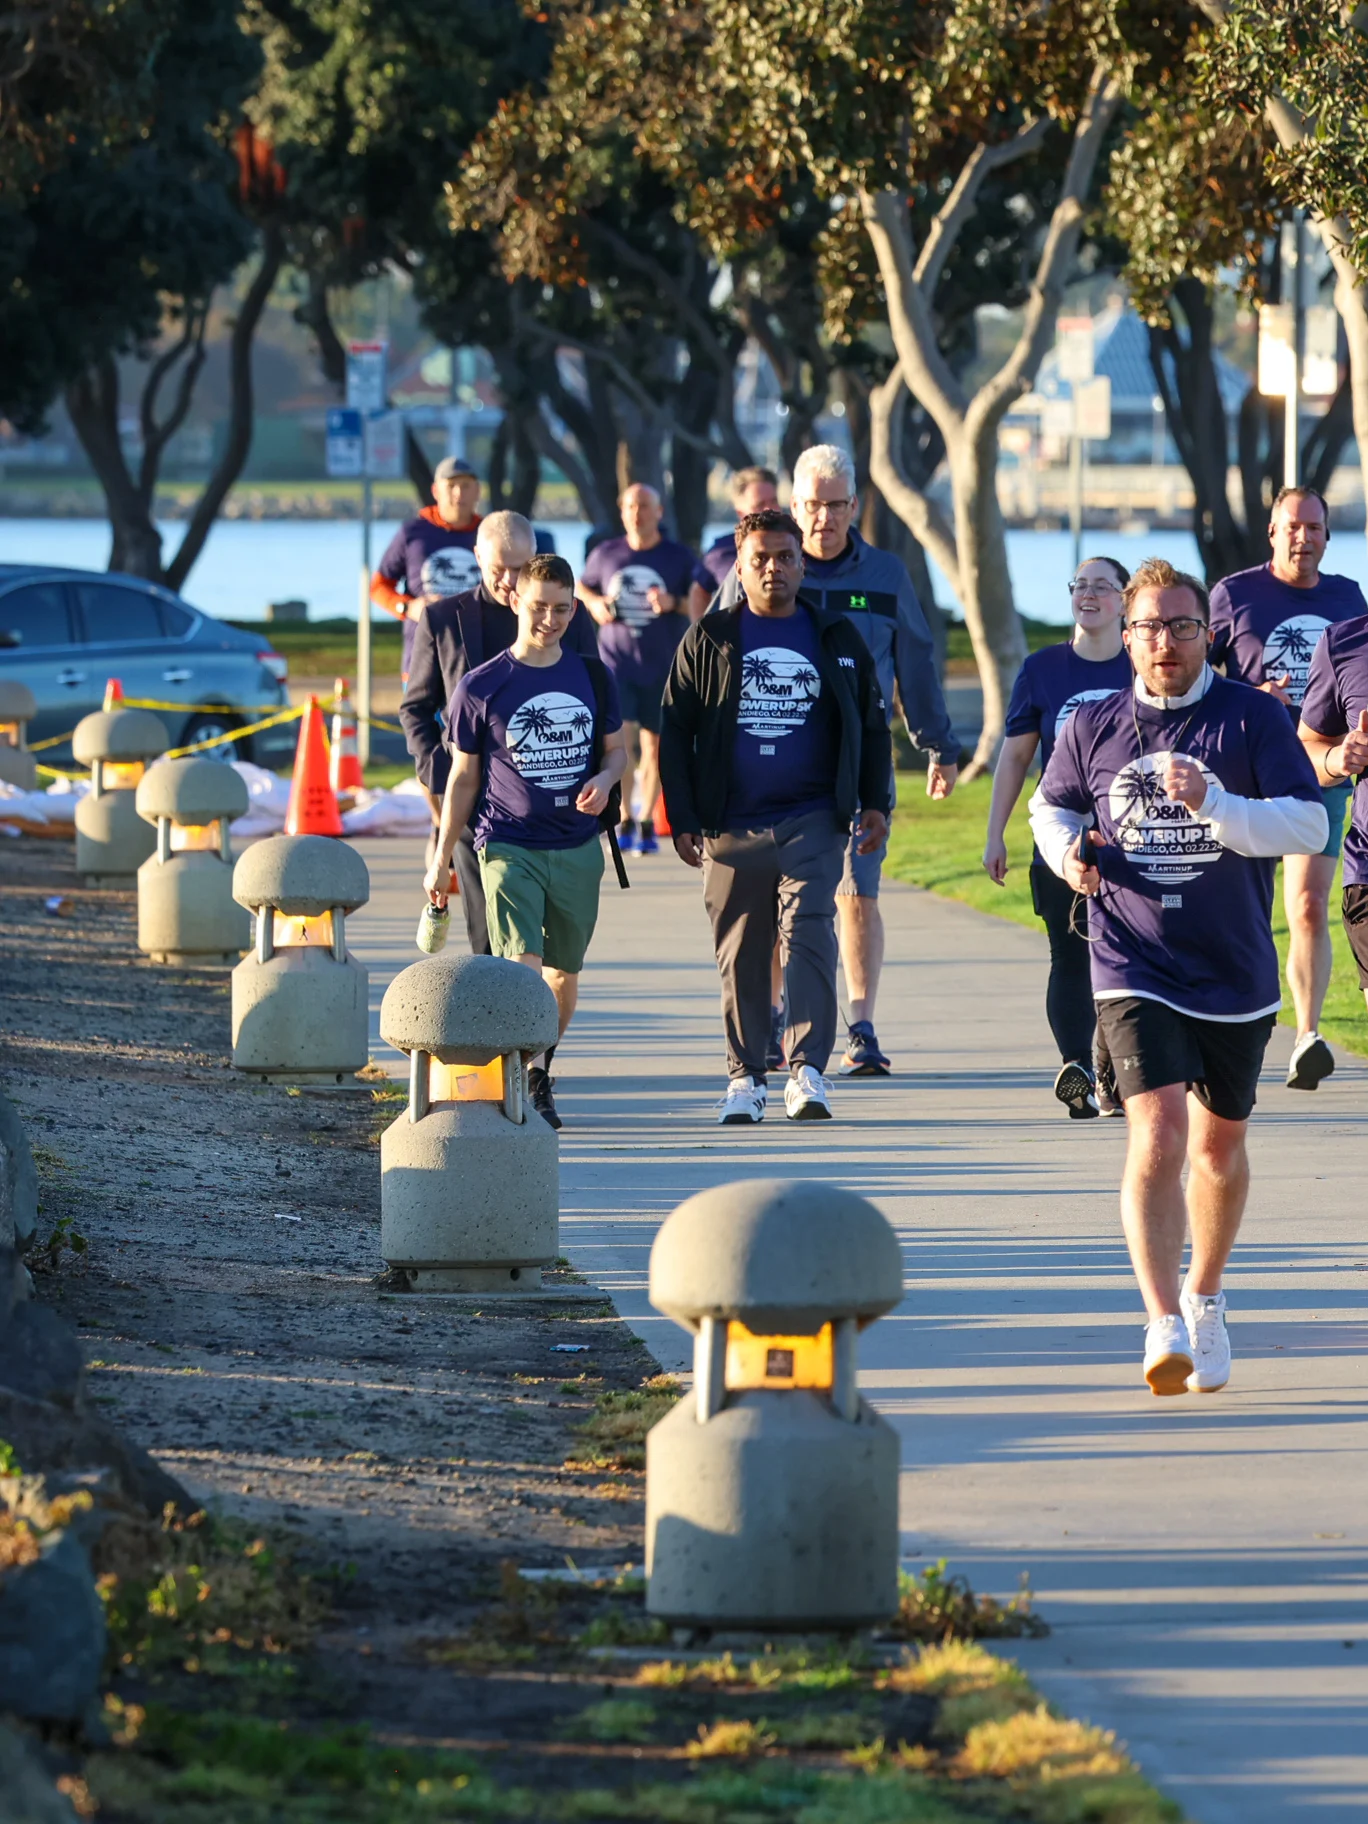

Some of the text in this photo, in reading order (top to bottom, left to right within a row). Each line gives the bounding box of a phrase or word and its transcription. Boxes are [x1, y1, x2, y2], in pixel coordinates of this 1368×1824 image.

[738, 700, 813, 712] OWERUP 5K
[511, 745, 591, 763] POWERUP 5K
[1204, 827, 1213, 842] 5
[1169, 845, 1183, 853] CA
[1185, 842, 1223, 853] 02.22.24
